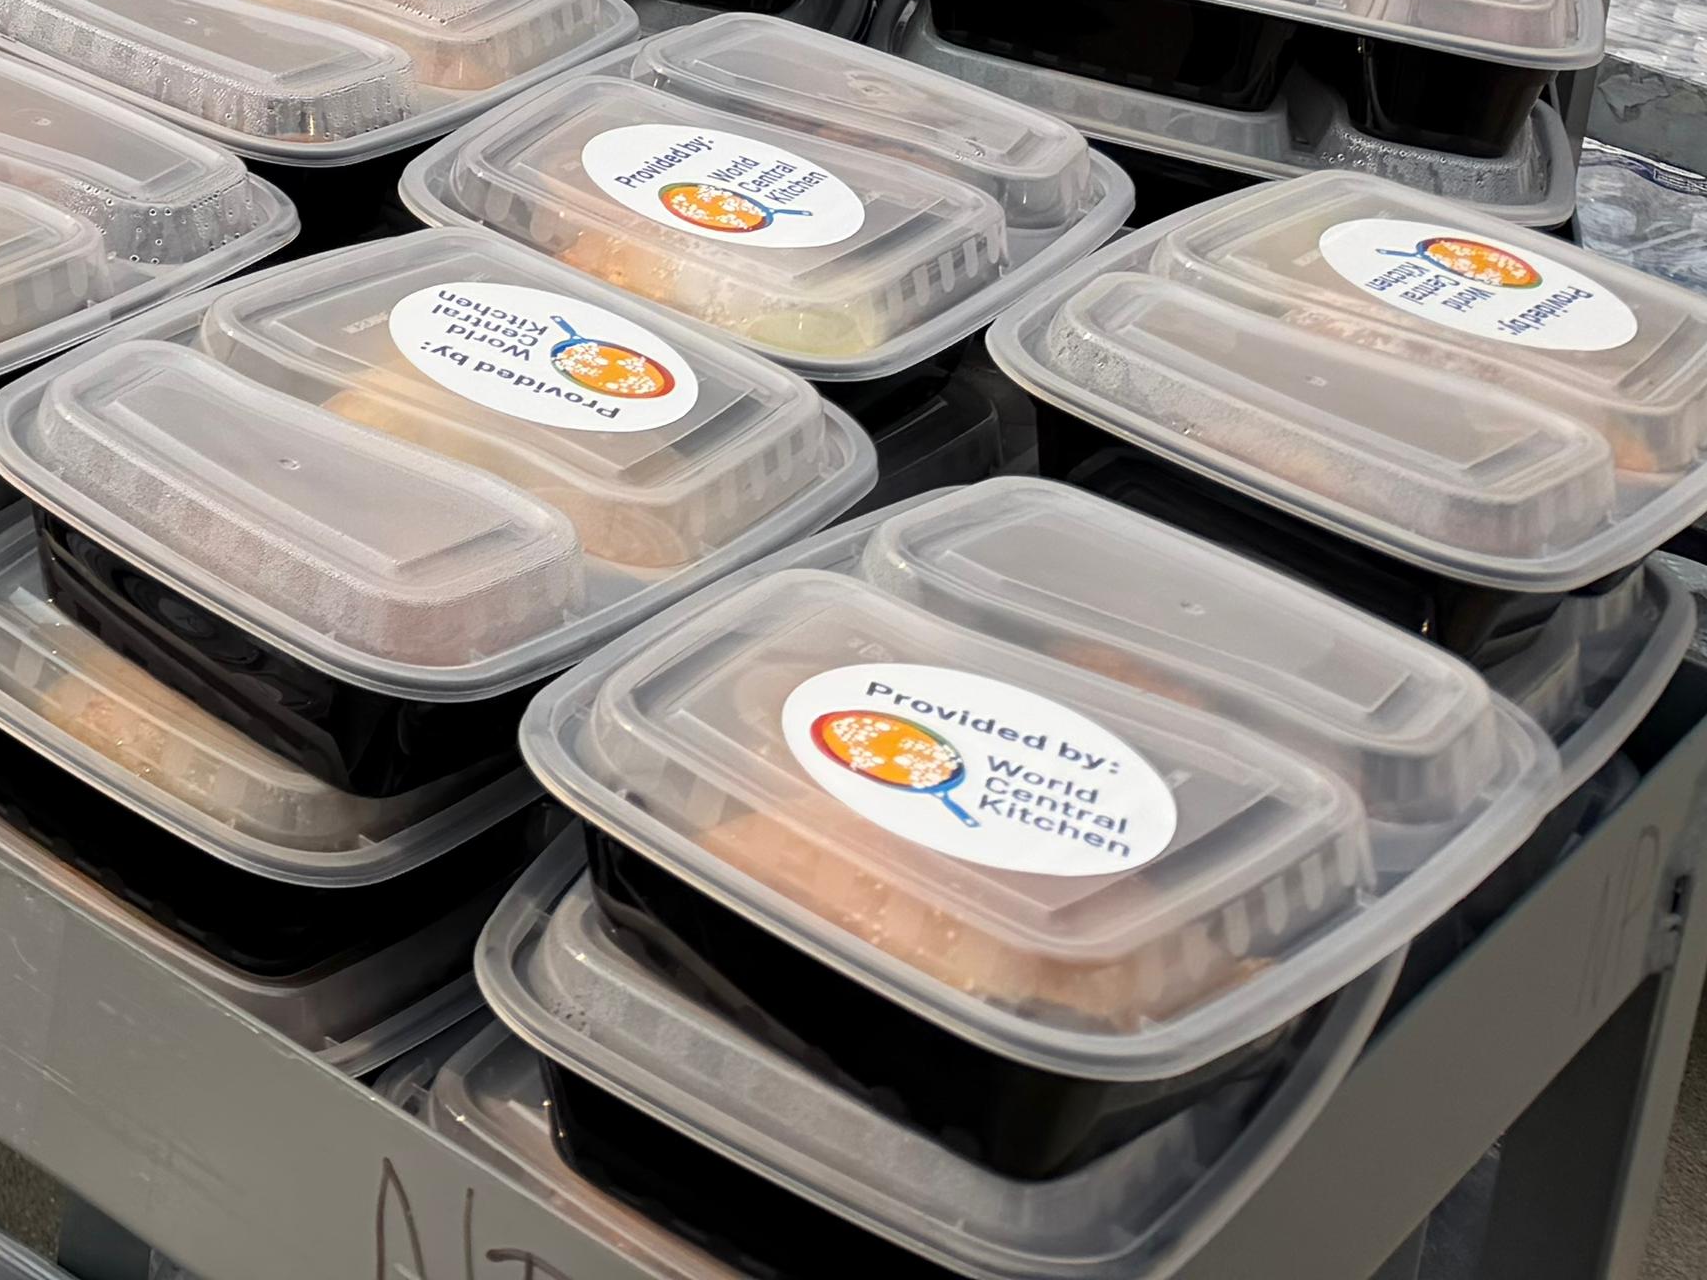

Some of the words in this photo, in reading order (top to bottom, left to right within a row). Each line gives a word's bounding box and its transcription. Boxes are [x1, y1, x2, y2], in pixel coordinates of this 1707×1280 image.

[613, 146, 692, 188] Provided
[675, 135, 714, 153] by:
[707, 155, 761, 182] World
[737, 159, 798, 192] Central
[763, 171, 829, 204] Kitchen
[1363, 260, 1429, 291] Kitchen
[1398, 274, 1460, 306] Central
[437, 290, 548, 336] Kitchen
[1439, 285, 1495, 312] World
[1517, 285, 1594, 326] Provided
[430, 303, 538, 346] Central
[445, 323, 529, 360] World
[420, 341, 469, 366] by:
[472, 360, 620, 419] Provided
[865, 681, 1048, 751] Provided
[1057, 741, 1119, 774] by:
[987, 755, 1099, 804] World
[978, 793, 1130, 857] Kitchen
[984, 776, 1128, 834] Central
